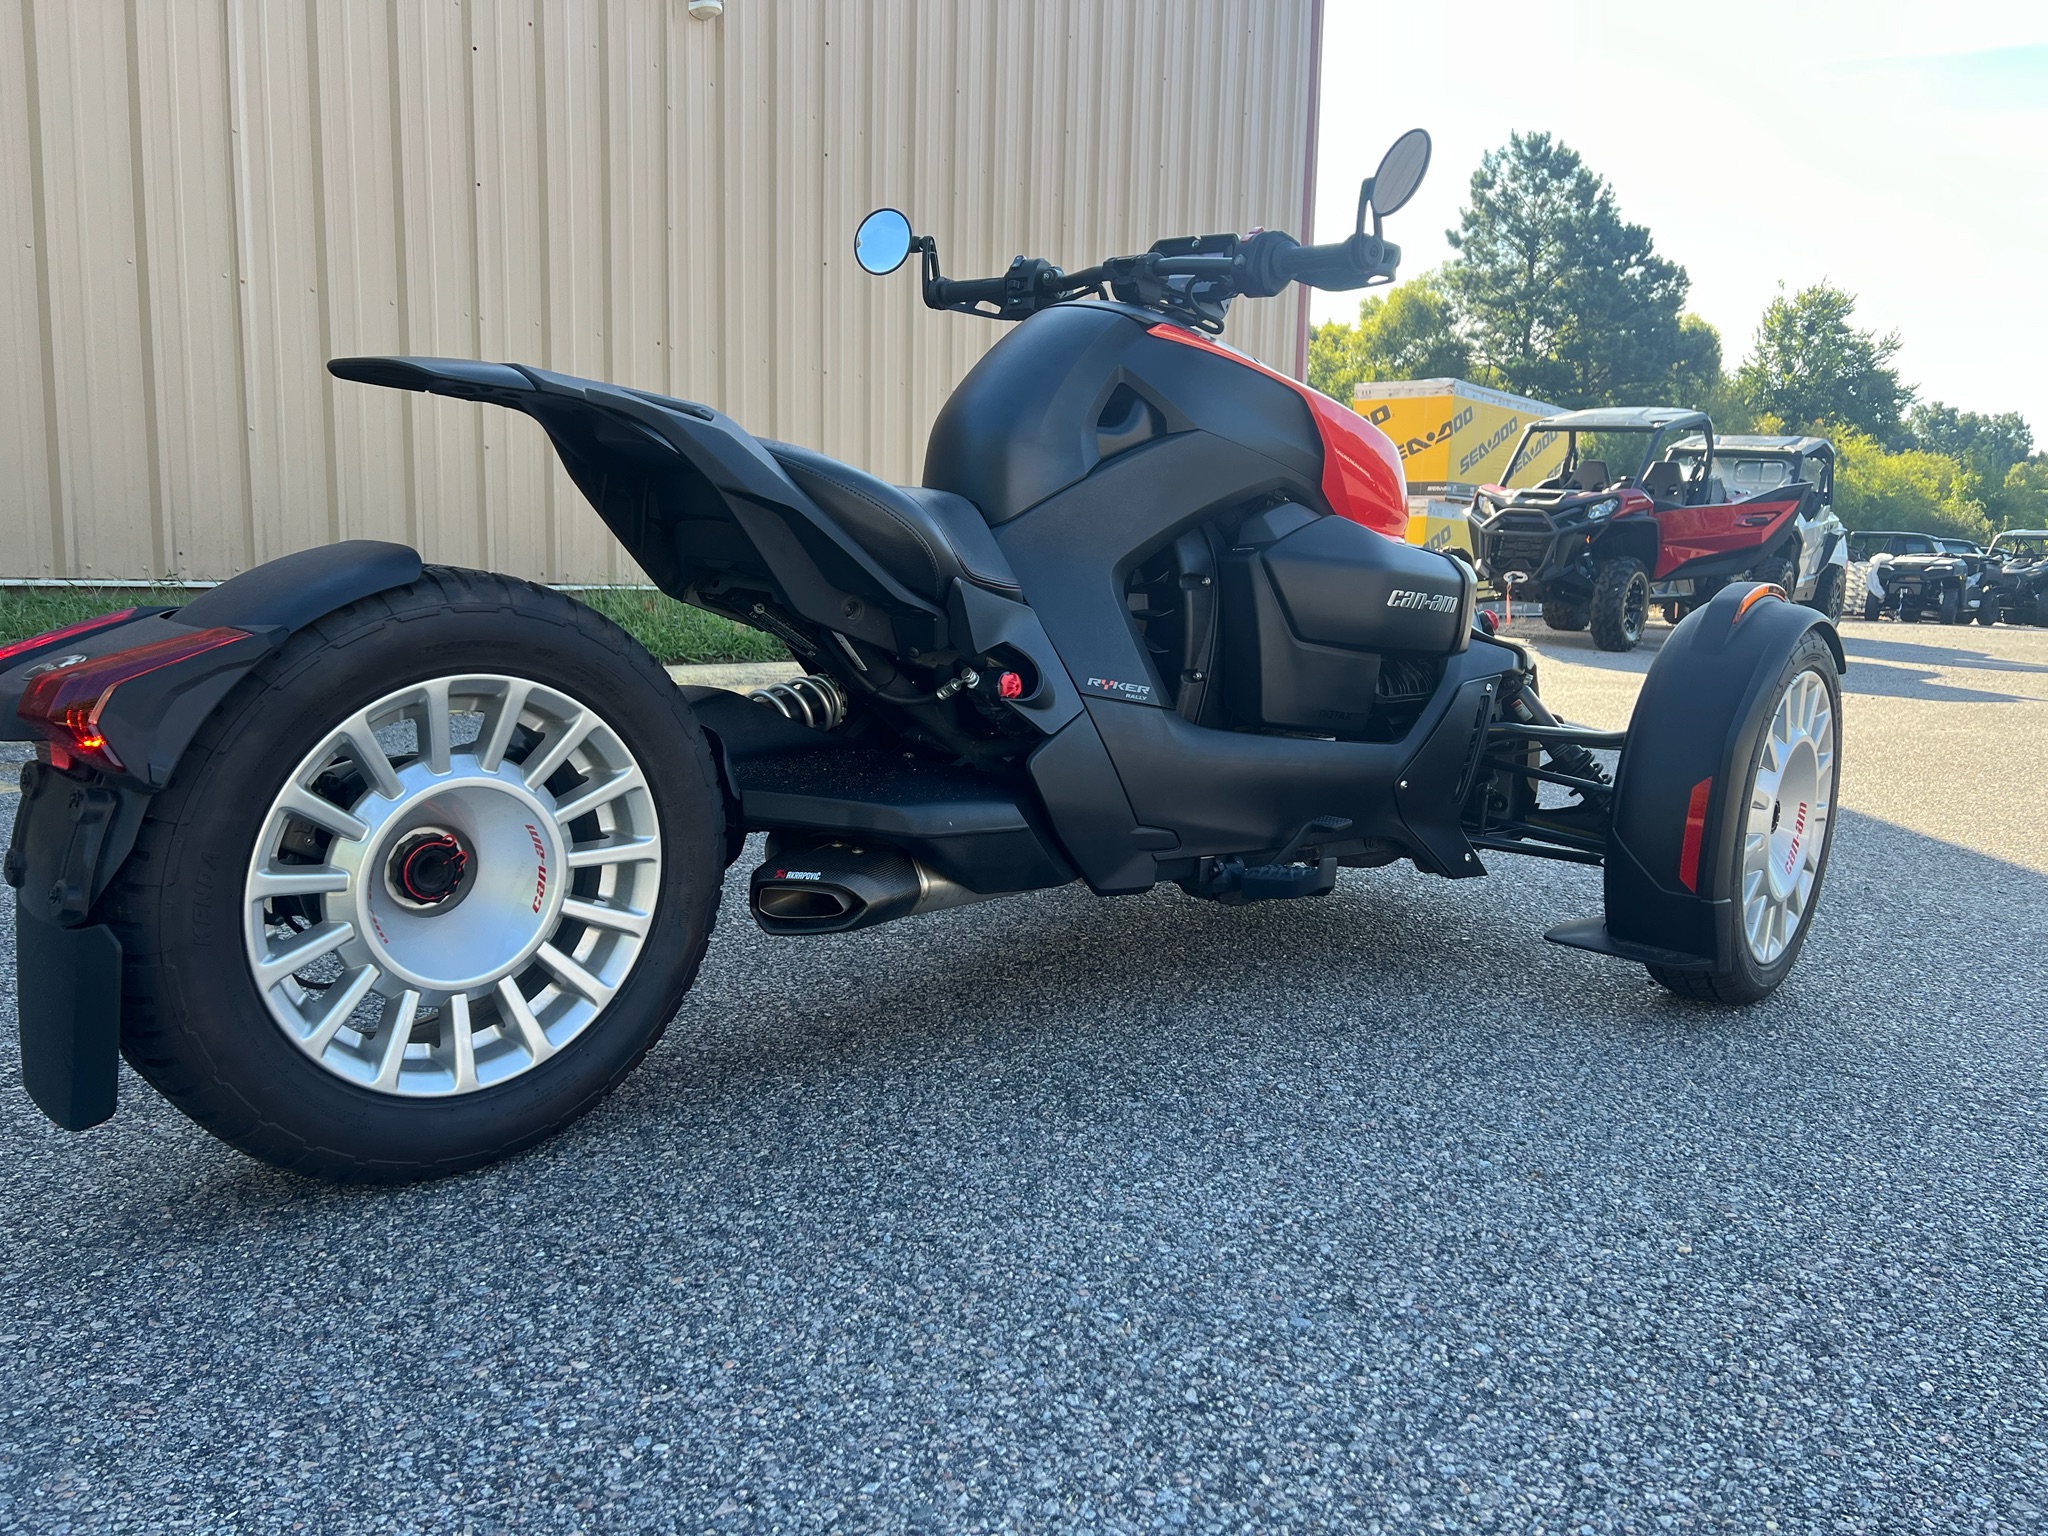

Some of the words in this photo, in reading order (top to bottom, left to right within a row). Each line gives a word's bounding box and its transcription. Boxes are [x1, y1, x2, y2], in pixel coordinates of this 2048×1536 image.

[1386, 589, 1458, 613] can-am
[1087, 677, 1151, 695] RYKER
[1125, 693, 1148, 701] RALLY
[1784, 801, 1807, 875] can-am
[524, 824, 547, 914] can-am
[192, 851, 217, 947] KENDA
